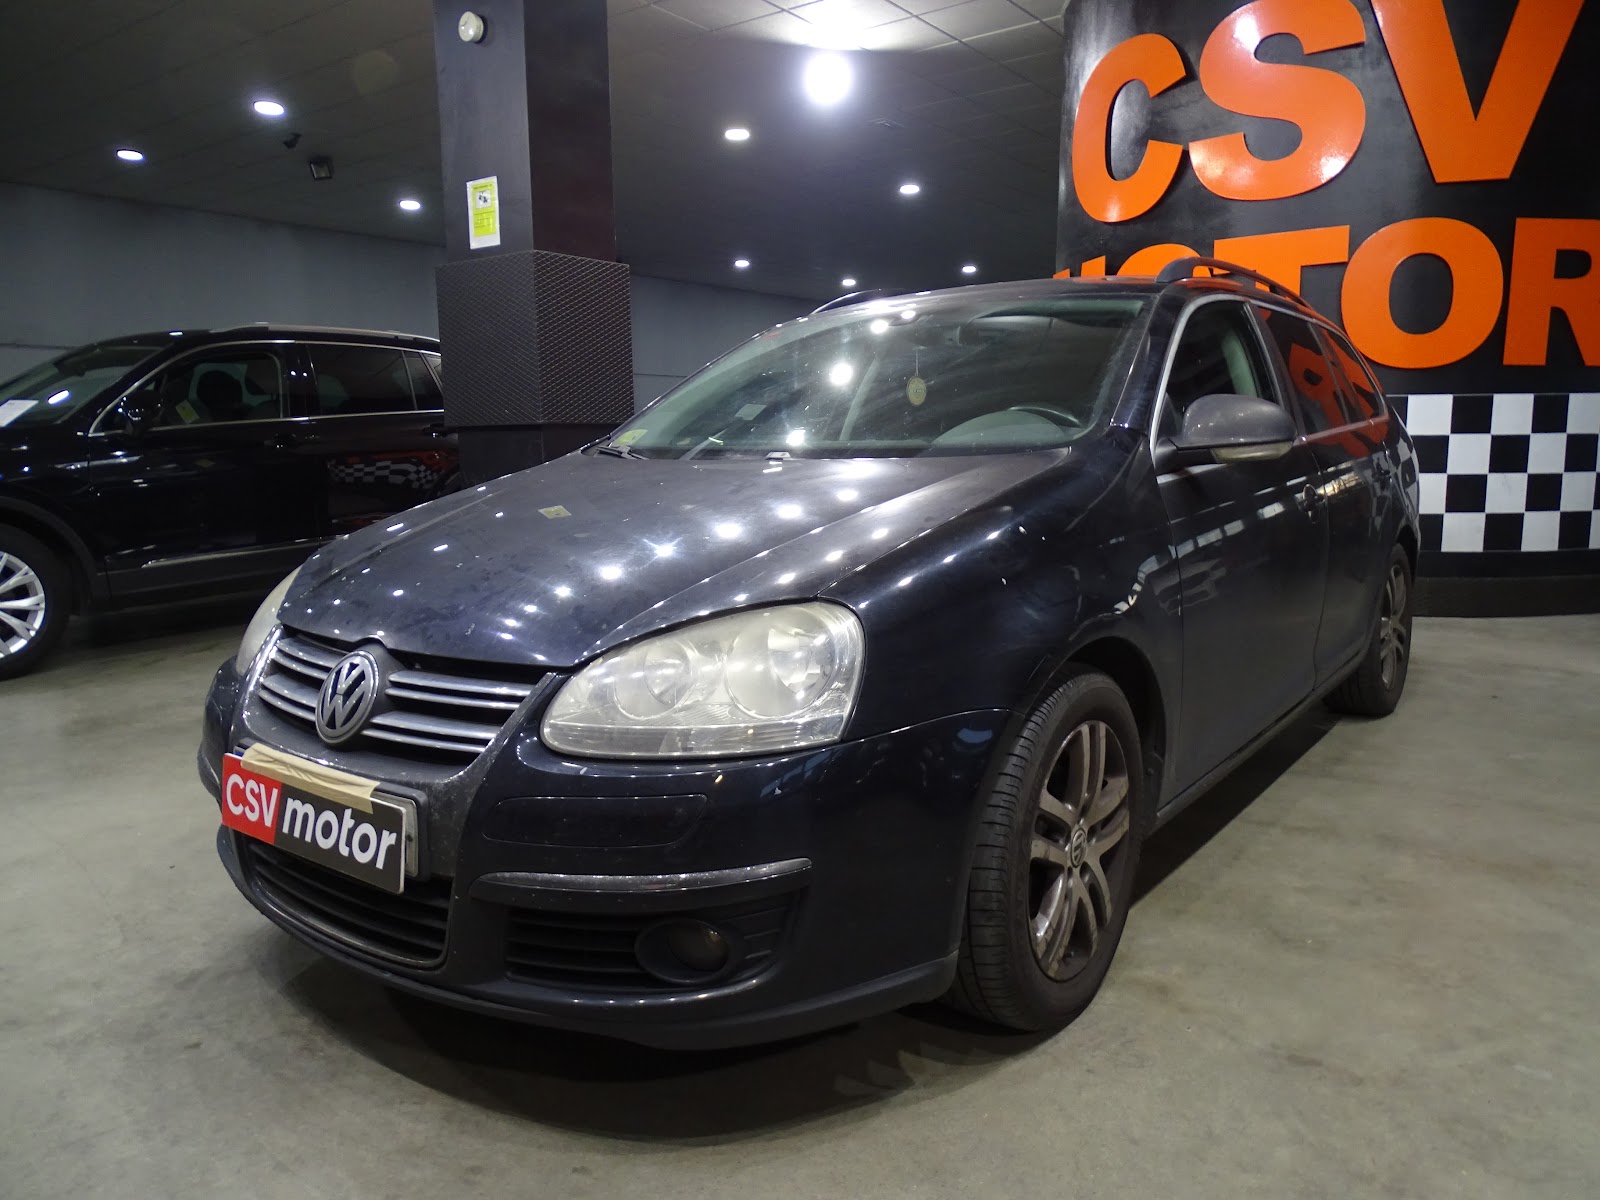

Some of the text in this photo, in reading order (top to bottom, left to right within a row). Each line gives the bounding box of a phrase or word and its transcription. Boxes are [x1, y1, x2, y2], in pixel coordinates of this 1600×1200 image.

[1071, 0, 1584, 223] CSV
[1053, 216, 1600, 369] TOR
[226, 773, 397, 870] CSV motor
